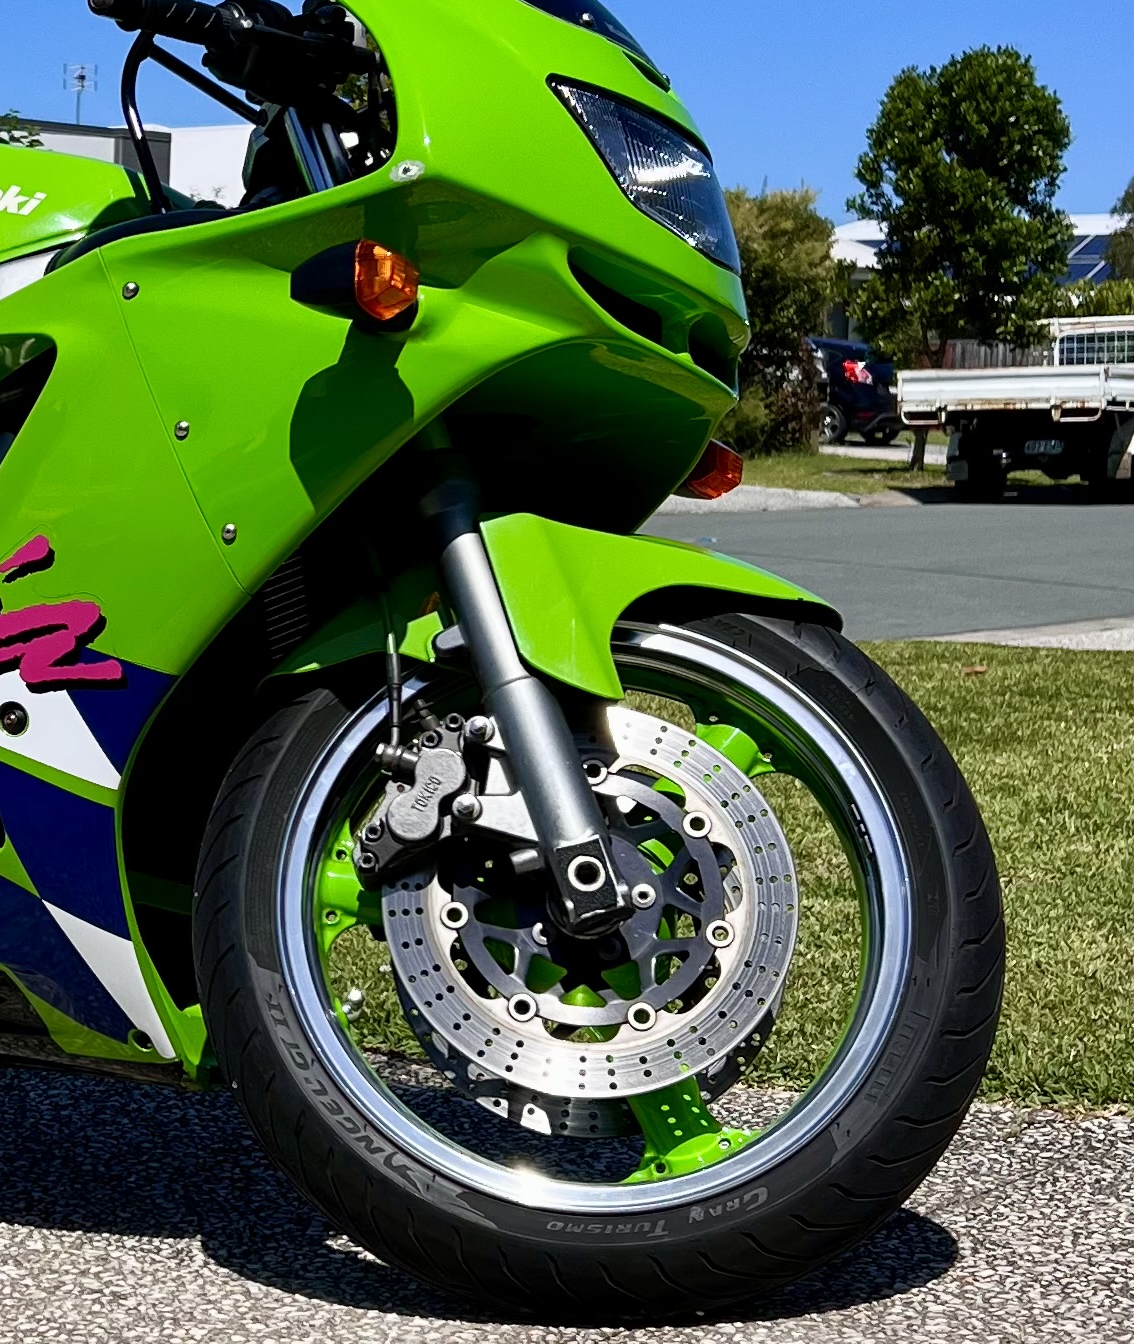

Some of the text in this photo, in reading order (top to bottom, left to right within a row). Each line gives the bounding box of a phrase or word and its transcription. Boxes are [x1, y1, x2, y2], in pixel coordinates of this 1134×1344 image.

[410, 775, 442, 812] TOKICO
[311, 1078, 424, 1196] ANGEL
[546, 1186, 769, 1238] GRAN TURISMO
